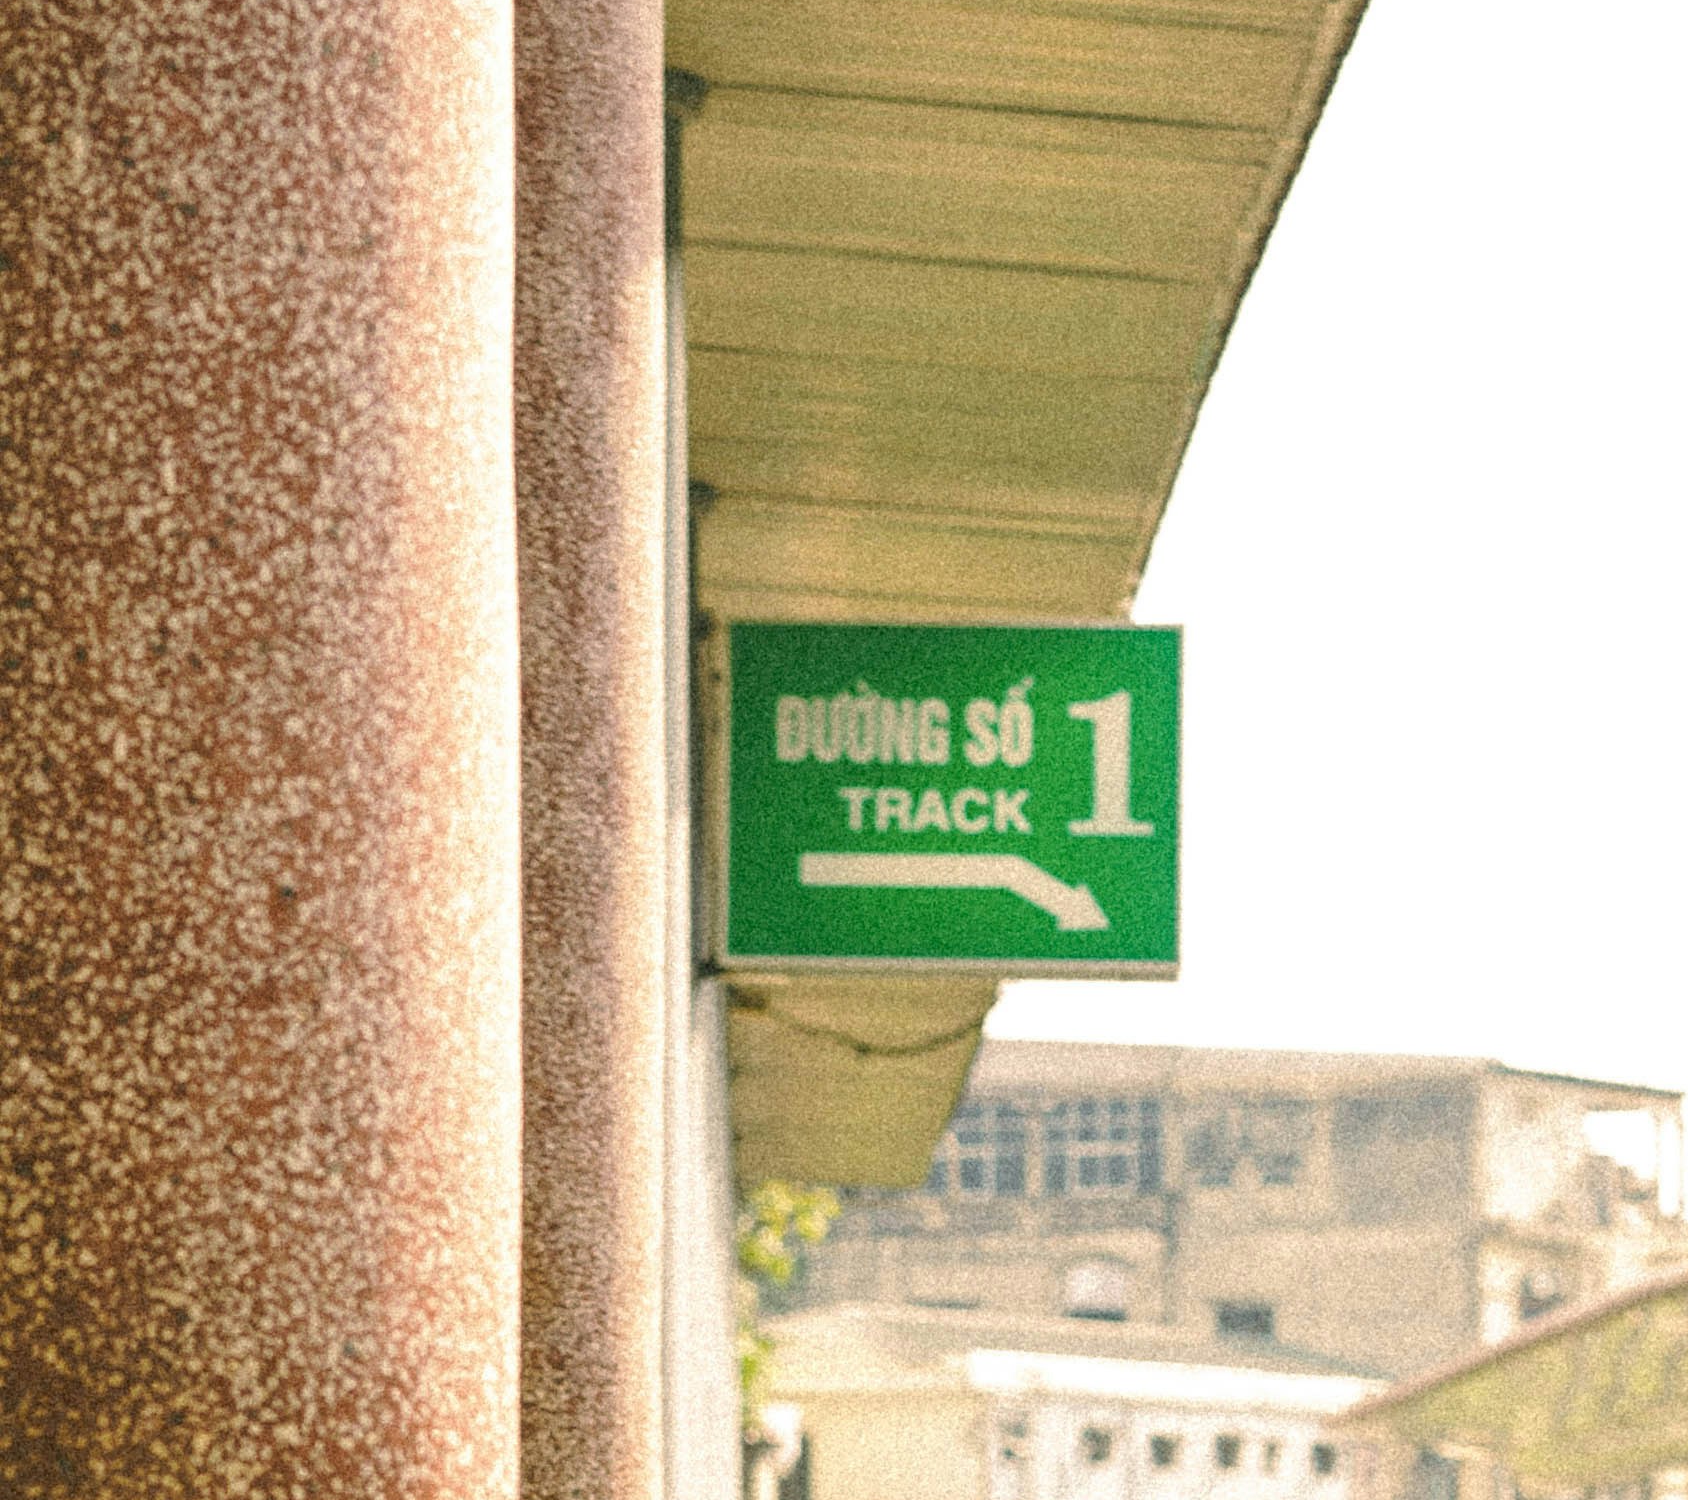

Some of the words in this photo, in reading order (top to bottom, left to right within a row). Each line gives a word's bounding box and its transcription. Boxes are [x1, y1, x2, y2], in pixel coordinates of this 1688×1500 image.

[964, 677, 1034, 766] SỐ
[1067, 690, 1154, 836] 1
[839, 787, 1032, 833] TRACK
